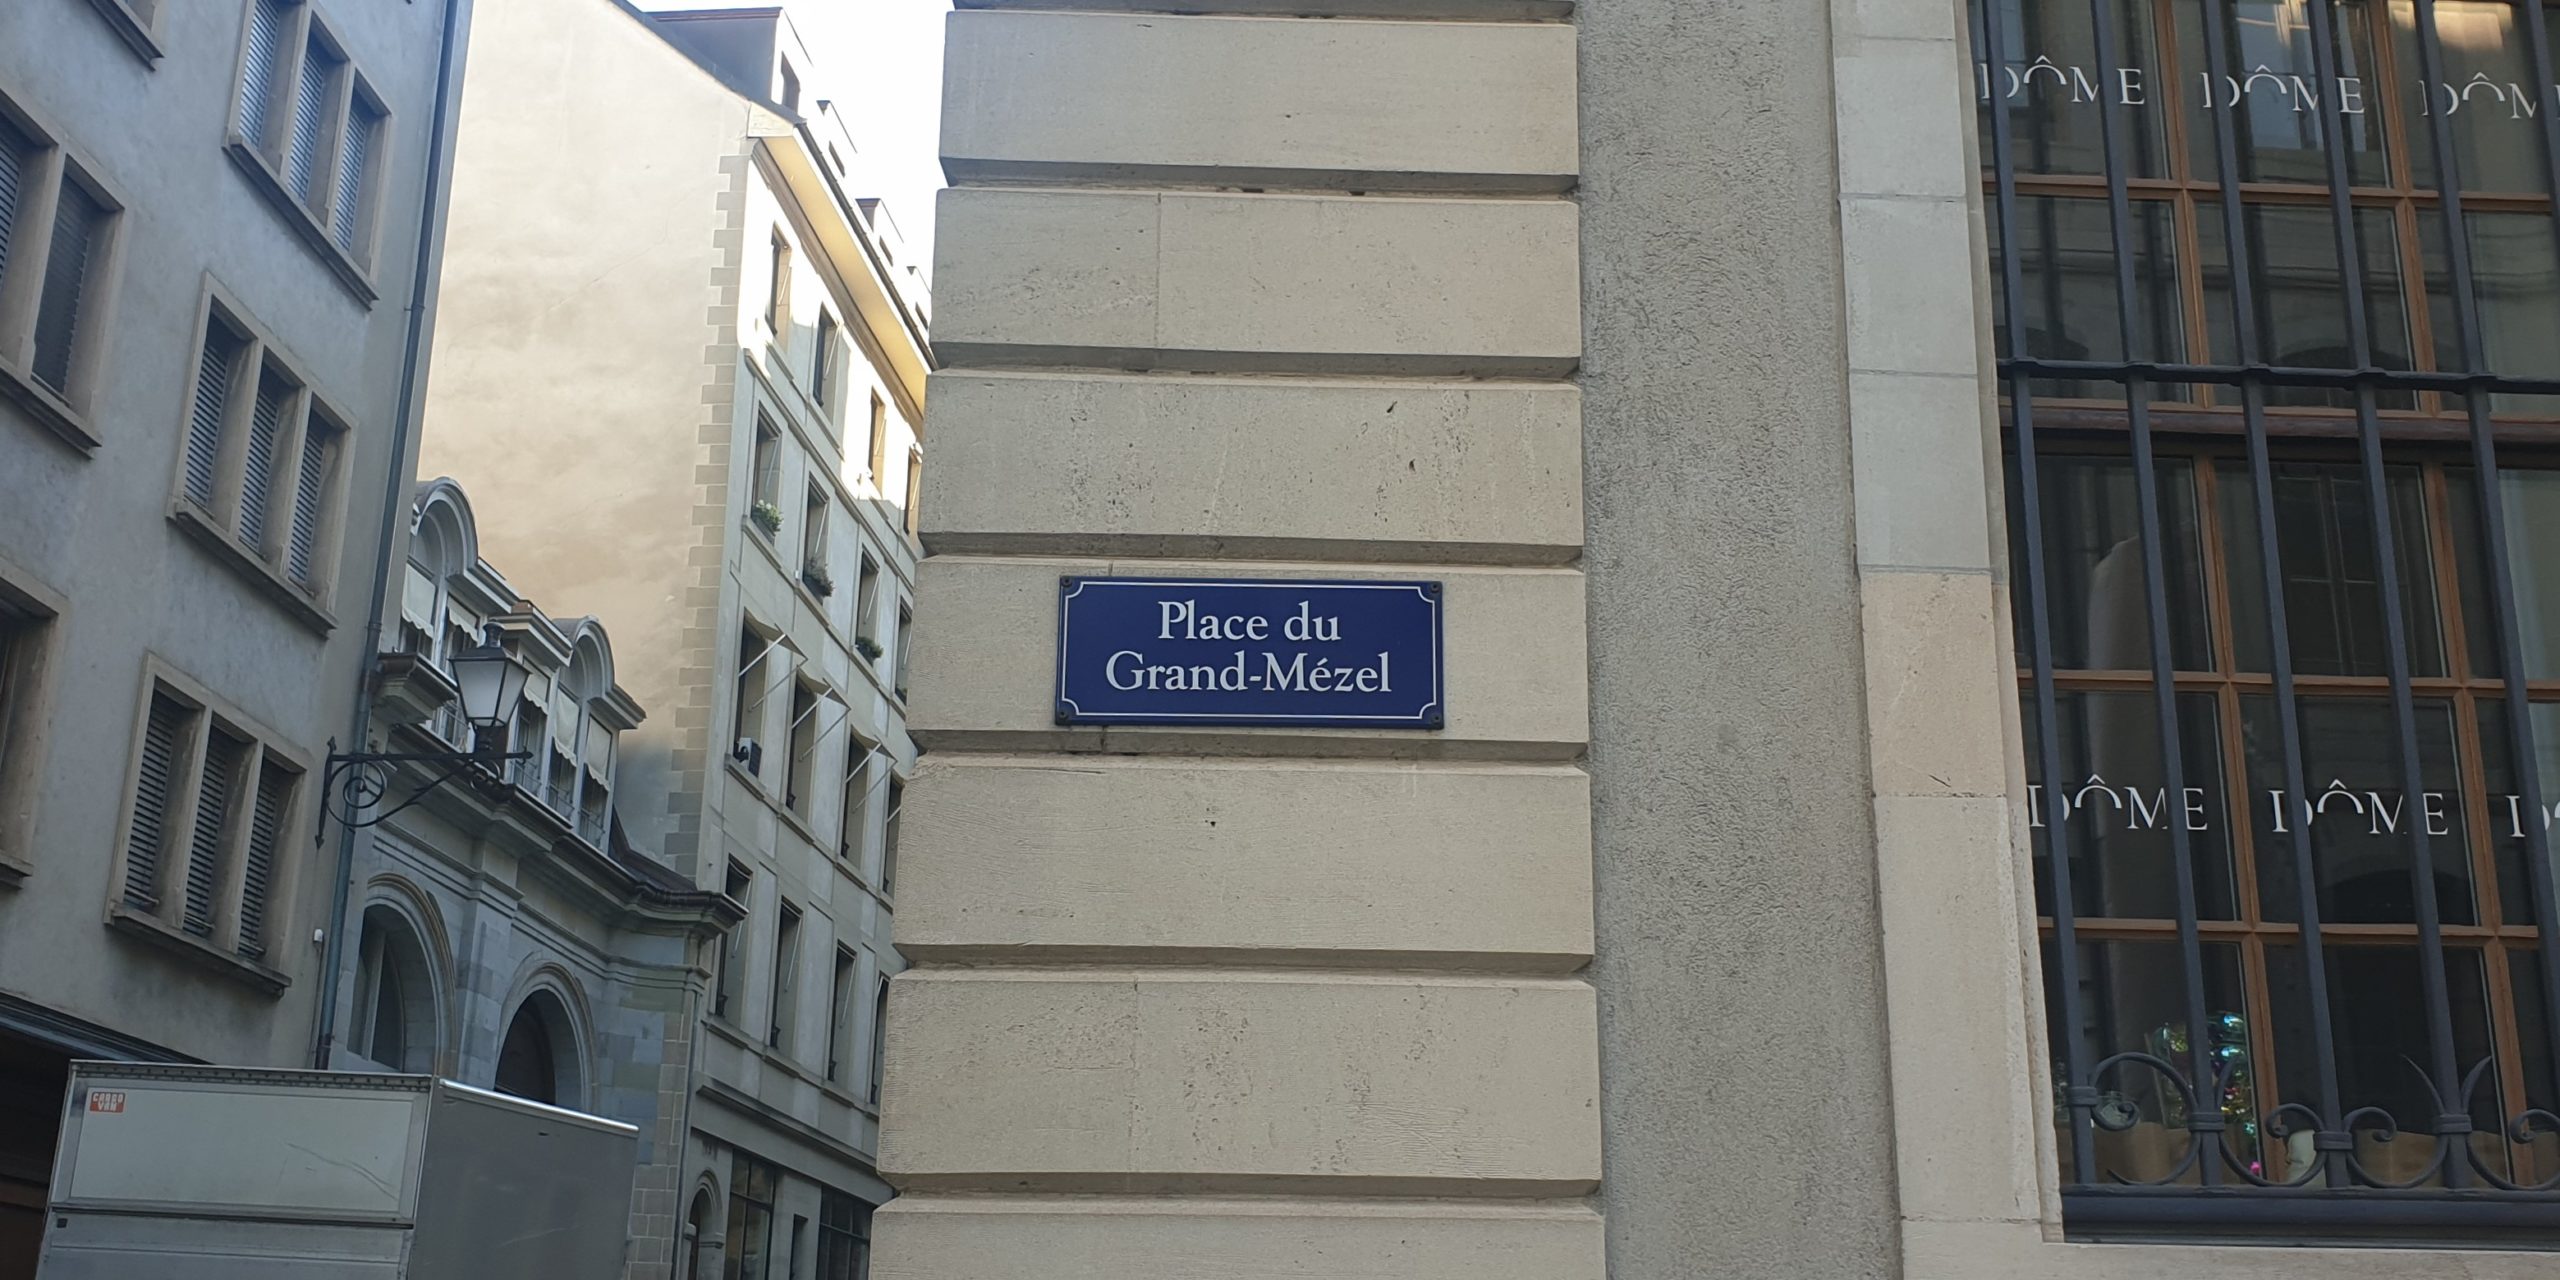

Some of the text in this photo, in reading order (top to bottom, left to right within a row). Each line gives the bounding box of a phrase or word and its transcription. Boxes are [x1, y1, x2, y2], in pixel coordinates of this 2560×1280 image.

[2200, 64, 2365, 114] DÔME
[2418, 71, 2560, 120] DÔM
[1158, 599, 1342, 641] Place du
[1105, 649, 1392, 693] Grand-Mézel
